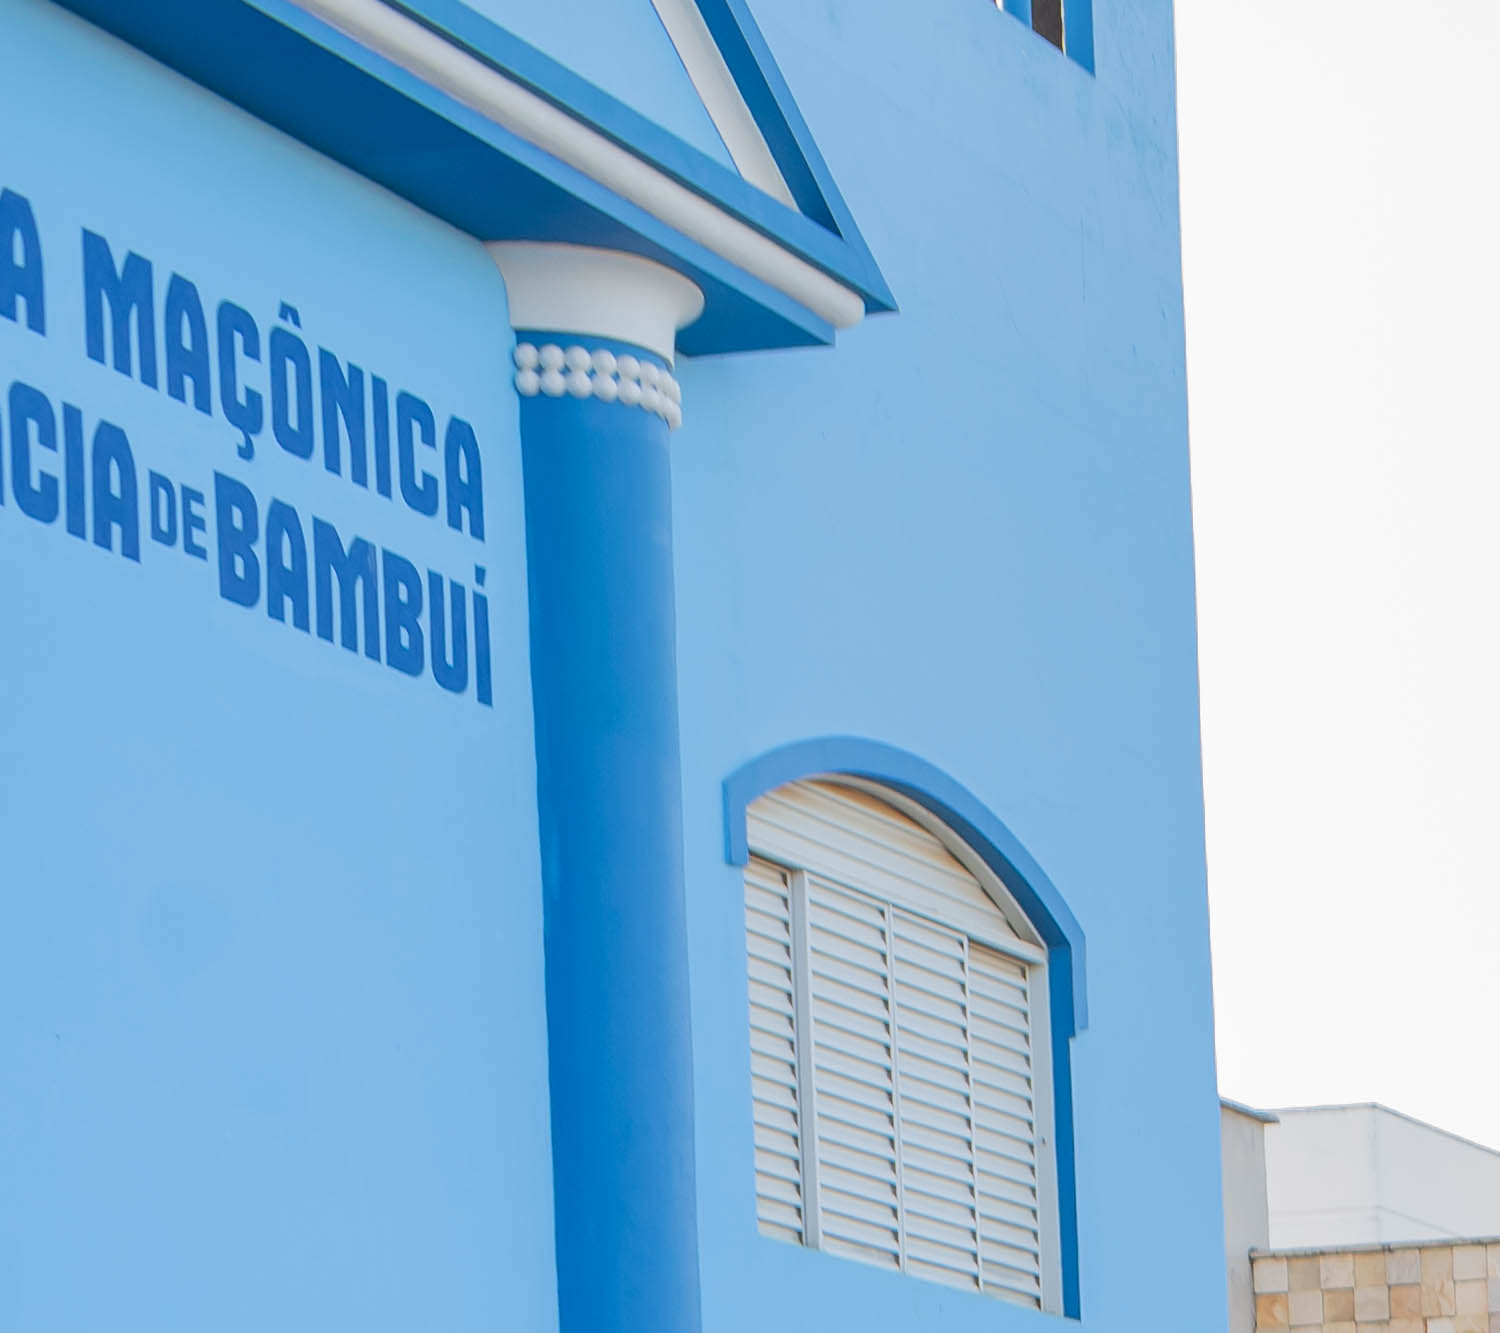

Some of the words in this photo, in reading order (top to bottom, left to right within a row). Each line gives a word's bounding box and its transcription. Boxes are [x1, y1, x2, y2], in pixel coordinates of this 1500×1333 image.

[81, 226, 486, 543] MAÇÔNICA
[149, 467, 208, 561] DE
[214, 470, 494, 709] BAMBUÍ
